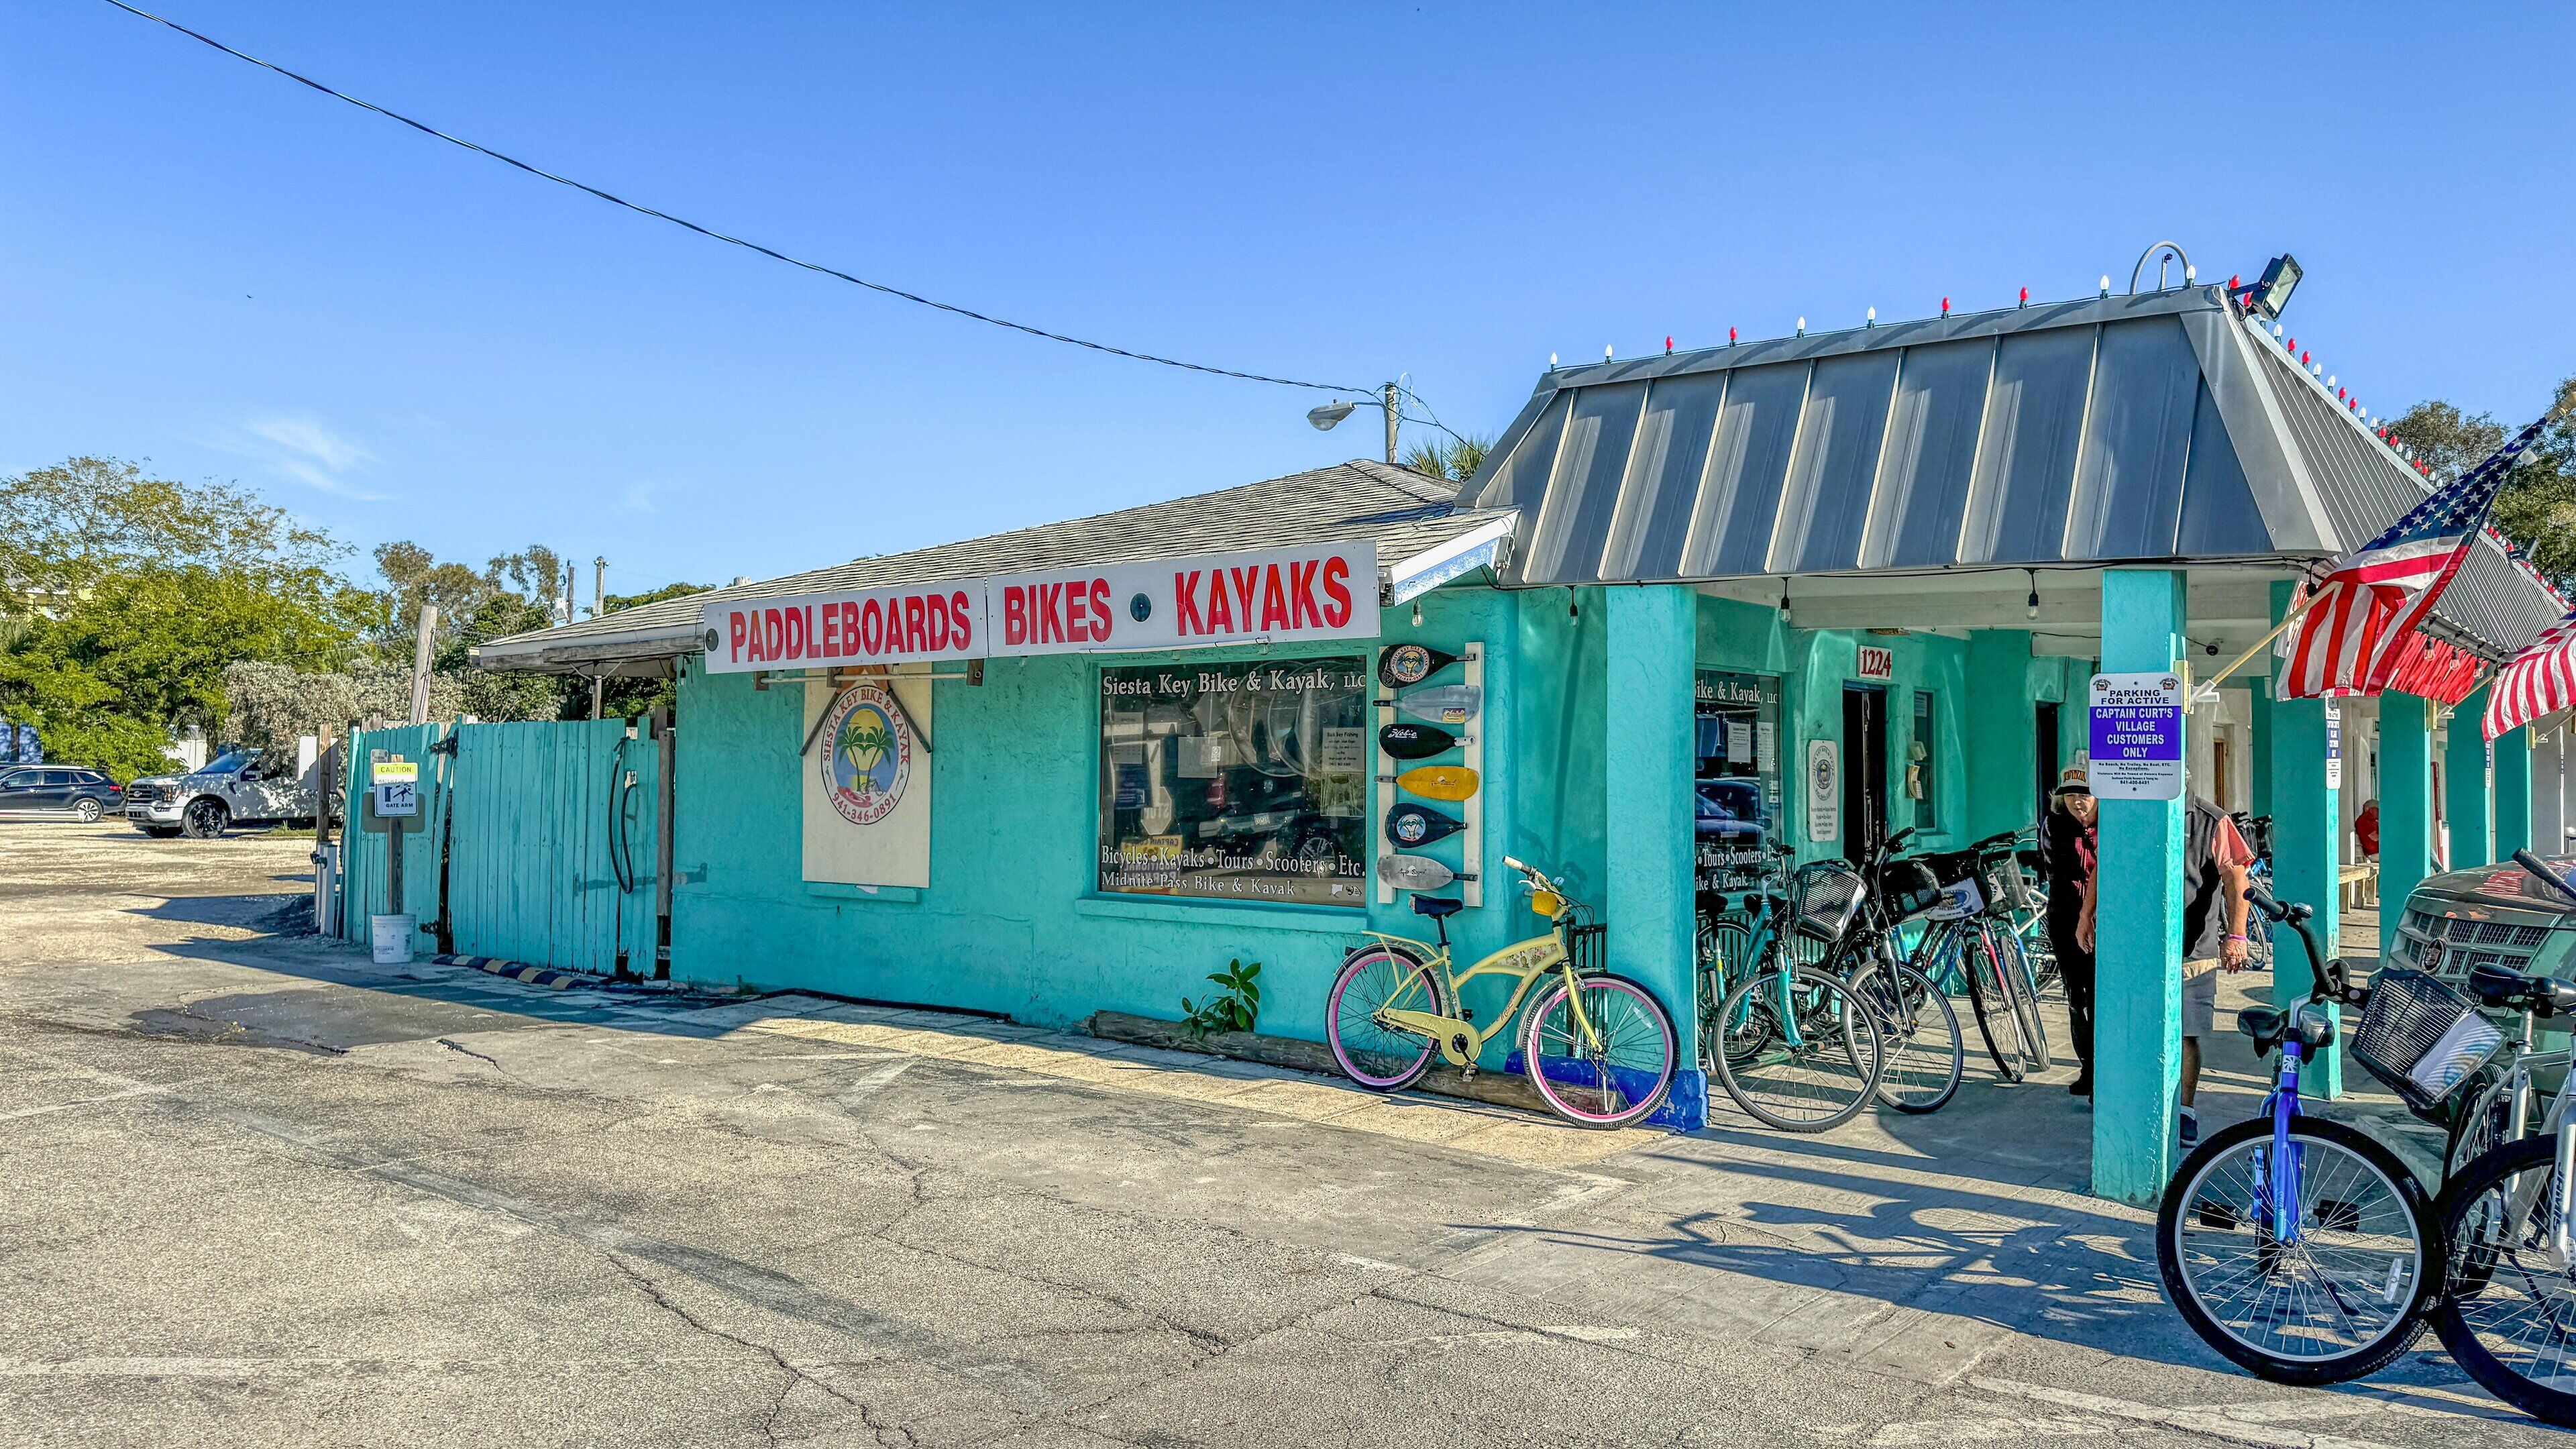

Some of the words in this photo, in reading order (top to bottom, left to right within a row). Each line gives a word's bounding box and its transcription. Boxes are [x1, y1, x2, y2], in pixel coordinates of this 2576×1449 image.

[1004, 578, 1113, 646] BIKES
[1175, 556, 1352, 637] KAYAKS
[729, 590, 972, 663] PADDLEBOARDS
[1861, 648, 1892, 678] 1224
[1103, 676, 1151, 696] Siesta
[1158, 674, 1191, 698] Key
[1198, 672, 1238, 693] Bike
[1246, 671, 1262, 692] &
[1270, 667, 1336, 695] Kayak,
[1344, 674, 1366, 688] LLC
[1695, 680, 1713, 700] ike
[1717, 681, 1726, 700] &
[1730, 682, 1764, 706] Kayak,
[2127, 696, 2169, 704] ACTIVE
[2096, 708, 2136, 719] CAPTAIN
[2139, 708, 2174, 718] CURT'S
[823, 714, 841, 761] SIESTA
[839, 691, 857, 713] KEY
[861, 688, 883, 704] BIKE
[883, 700, 892, 710] &
[890, 709, 910, 764] KAYAK
[1387, 729, 1418, 739] Hobie
[2115, 720, 2155, 732] VILLAGE
[2106, 734, 2165, 745] CUSTOMERS
[2123, 747, 2148, 758] ONLY
[832, 793, 897, 822] 941-346-0891
[1101, 845, 1149, 868] Bicycles
[1160, 845, 1205, 875] Kayaks
[1216, 849, 1254, 870] Tours
[1265, 851, 1326, 874] Scooters
[1338, 855, 1366, 877] Etc.
[1702, 847, 1725, 867] Tours
[1730, 845, 1762, 865] Scooters
[1101, 870, 1153, 888] Midnite
[1160, 875, 1188, 890] Pass
[1195, 875, 1225, 892] Bike
[1232, 877, 1243, 892] &
[1695, 875, 1709, 891] ike
[1712, 873, 1719, 890] &
[1722, 871, 1748, 891] Kayak
[2553, 1161, 2565, 1232] JAMIS
